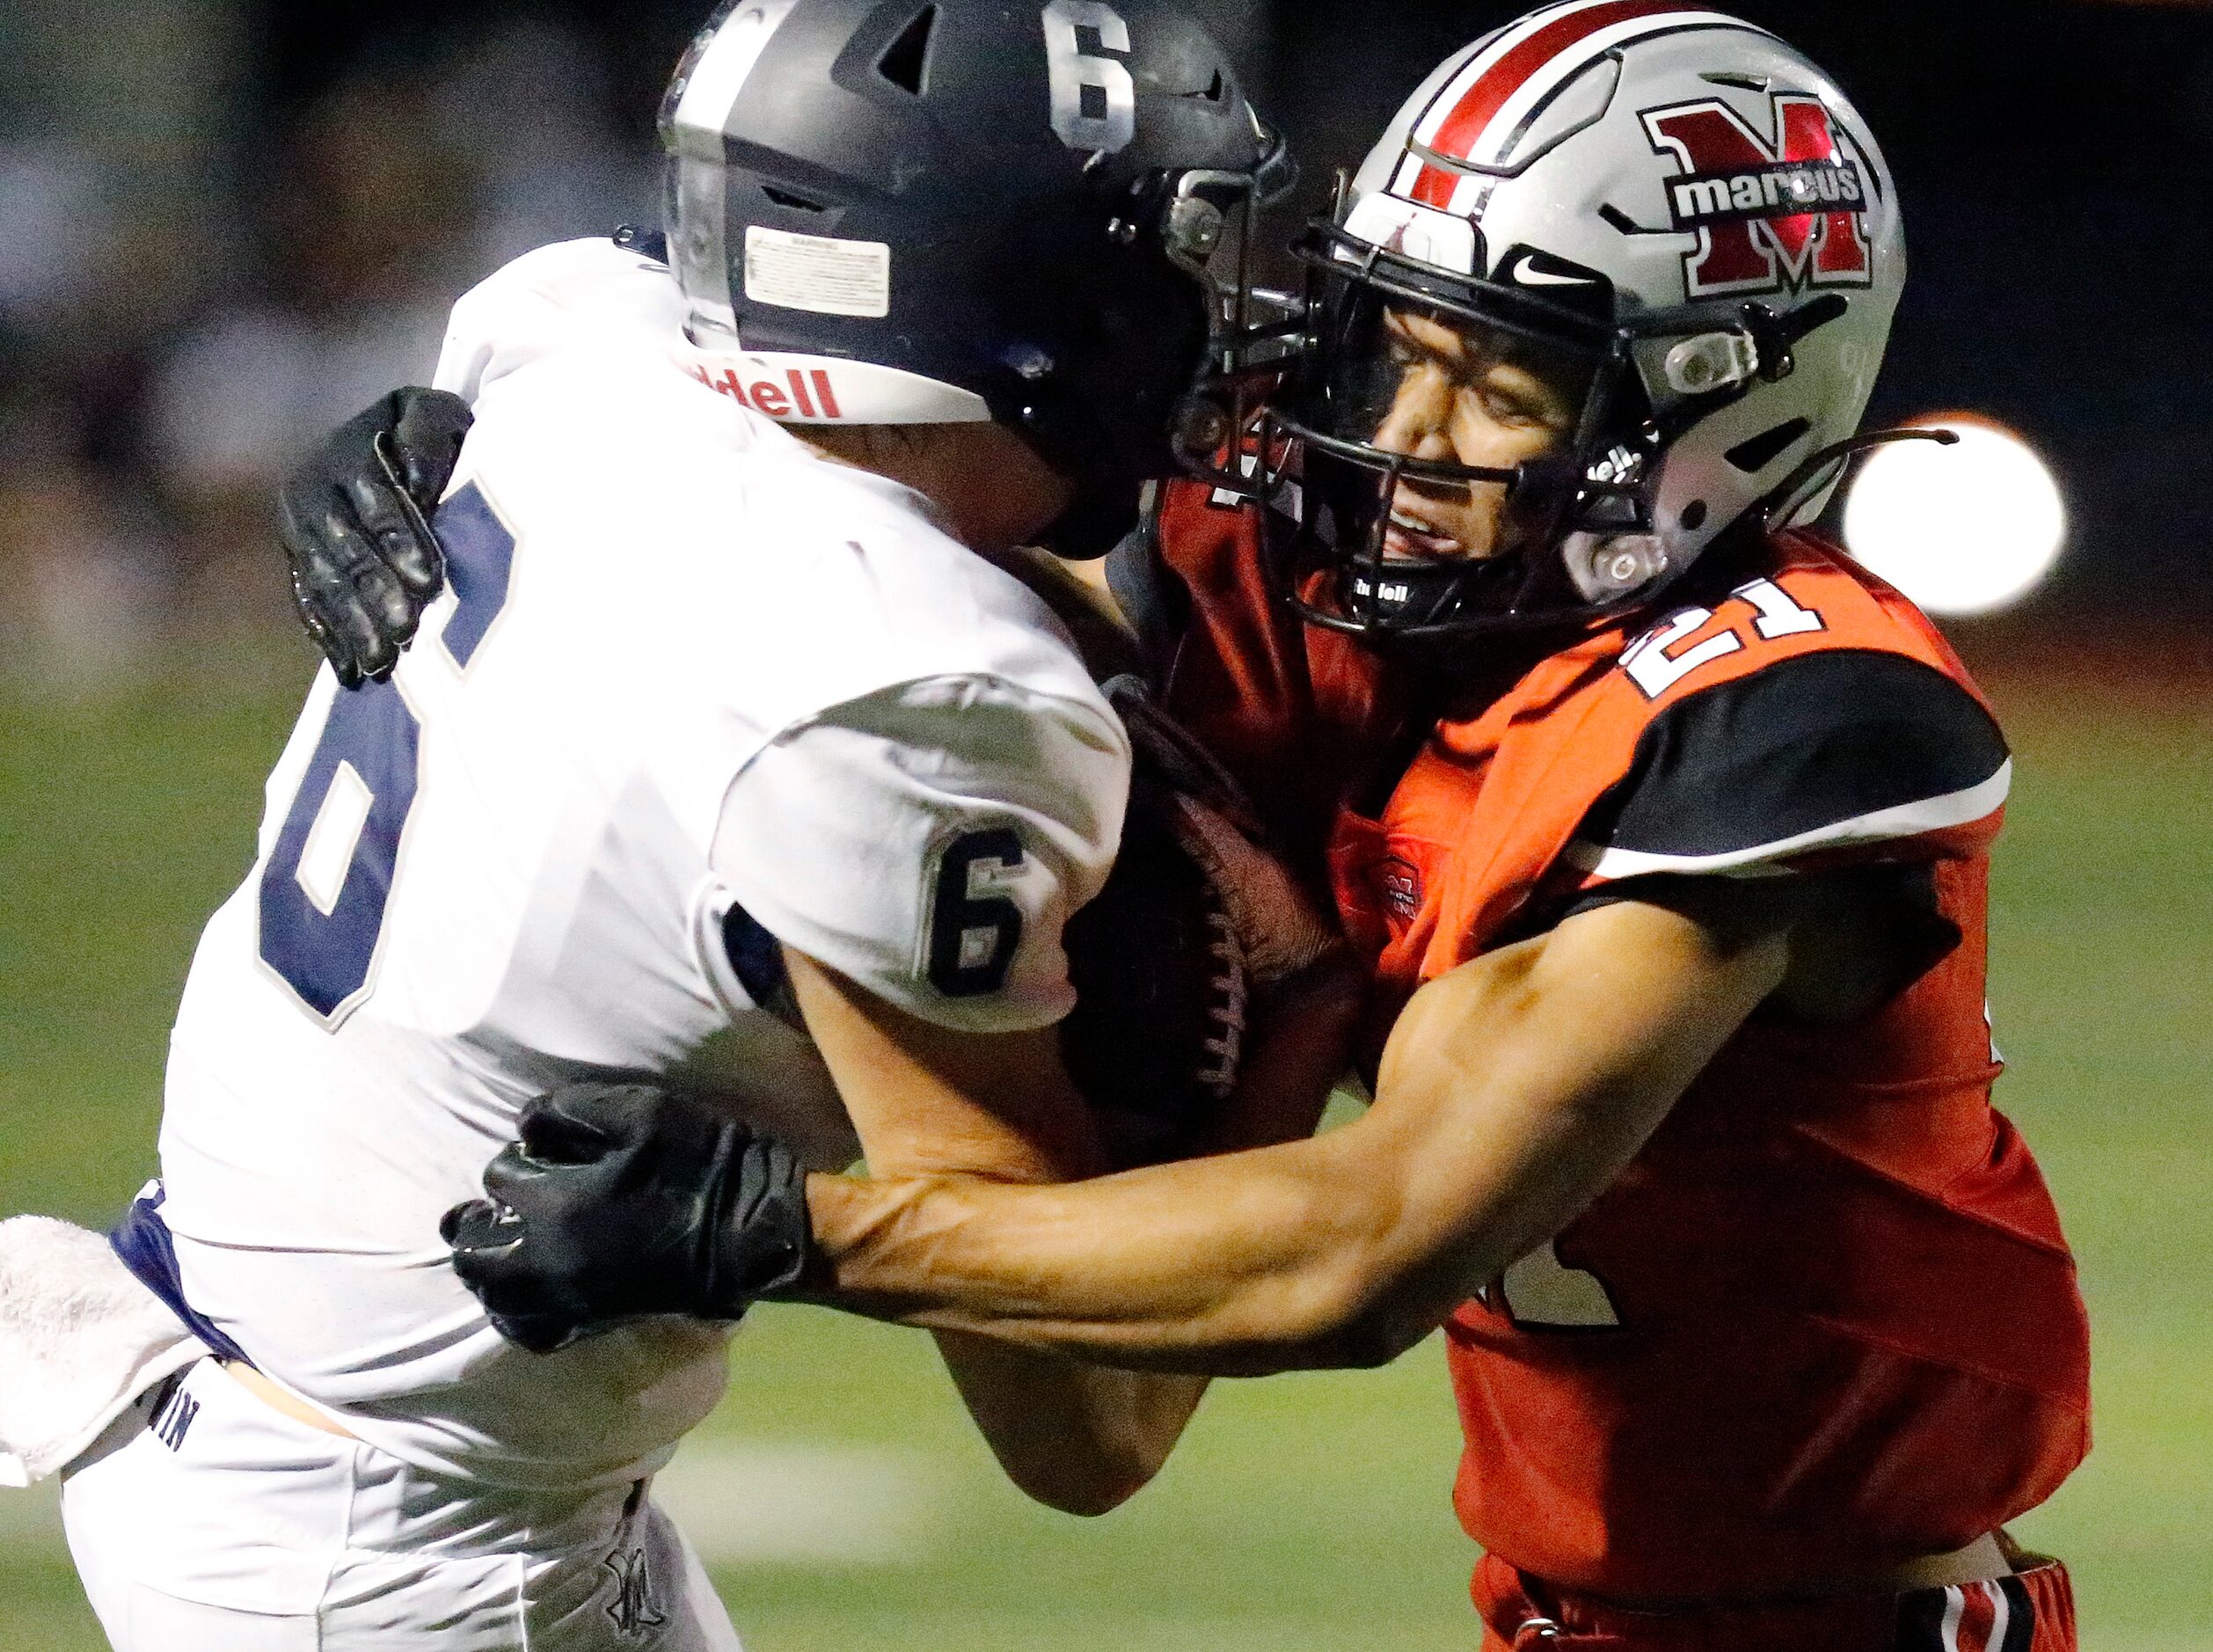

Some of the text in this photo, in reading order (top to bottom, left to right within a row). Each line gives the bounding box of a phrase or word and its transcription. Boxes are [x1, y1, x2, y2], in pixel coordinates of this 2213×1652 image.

[1041, 0, 1134, 153] 6
[1673, 168, 1860, 218] marcus
[1618, 577, 1828, 700] 21
[928, 828, 1025, 998] 6
